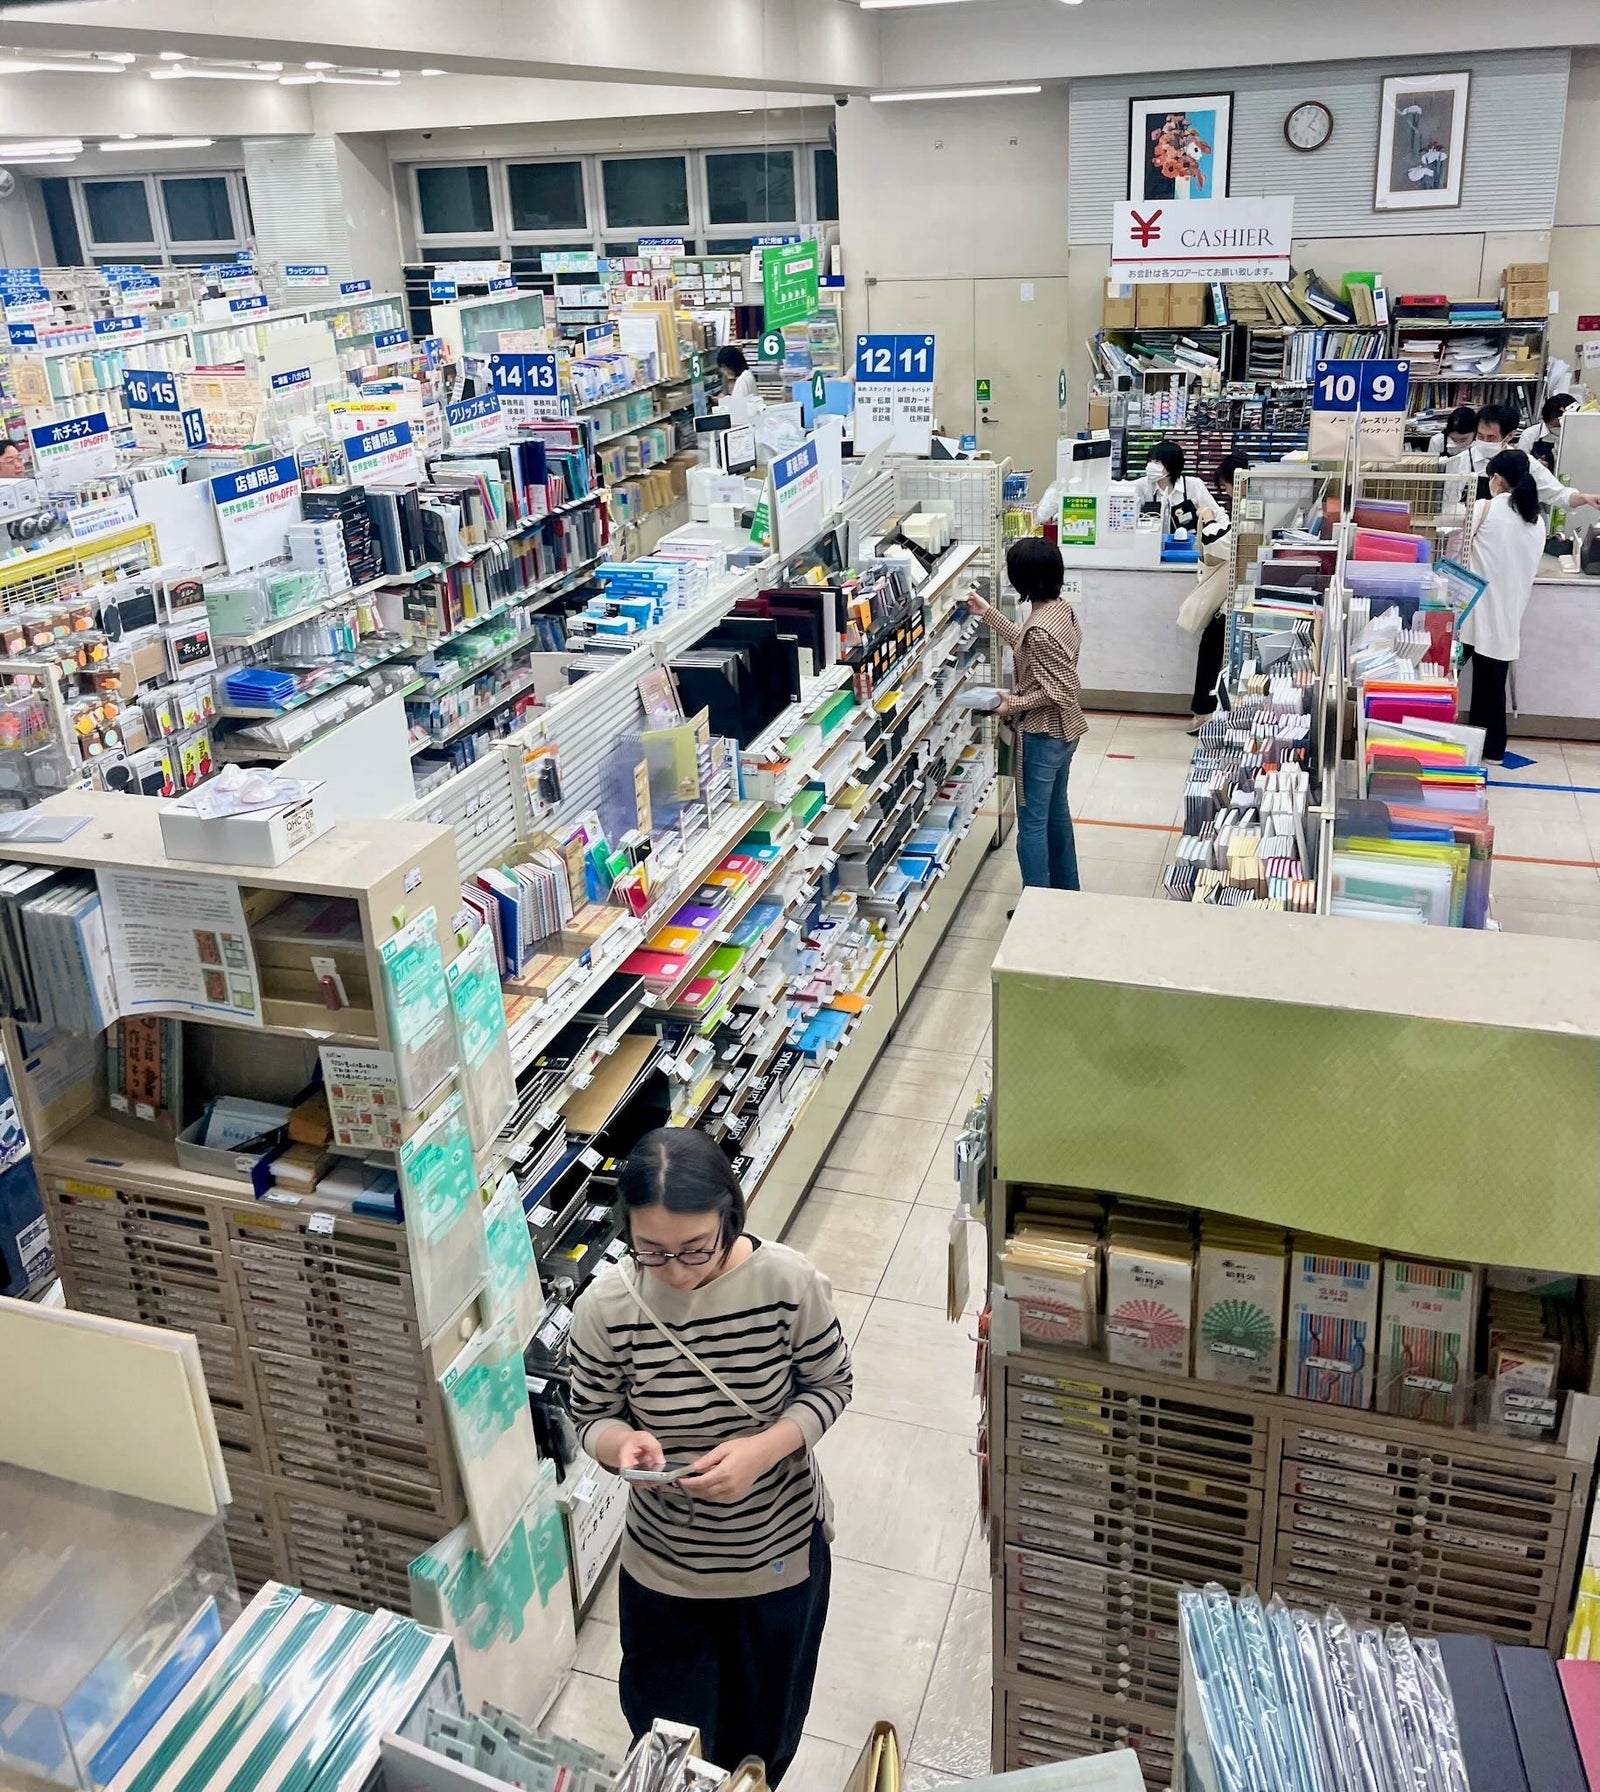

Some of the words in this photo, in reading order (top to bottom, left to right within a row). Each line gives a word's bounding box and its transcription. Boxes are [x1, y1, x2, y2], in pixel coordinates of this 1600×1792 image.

[1180, 228, 1274, 248] CASHIER
[1128, 267, 1274, 279] お会計は各フロアーにてお願い致します。
[763, 335, 780, 356] 6
[692, 356, 701, 378] 5
[861, 348, 892, 373] 12
[899, 348, 927, 373] 11
[495, 365, 522, 387] 14
[527, 365, 555, 388] 13
[815, 375, 824, 400] 4
[127, 380, 148, 402] 16
[152, 382, 176, 404] 15
[1060, 375, 1066, 401] 3
[1319, 374, 1356, 402] 10
[1372, 374, 1395, 402] 9
[450, 396, 499, 424] クリップボード
[1360, 416, 1401, 424] ルーズリーフ
[52, 420, 93, 441] ホチキス
[185, 412, 203, 444] 15
[362, 429, 398, 453] 店舗用品
[235, 465, 280, 493] 店舗用品
